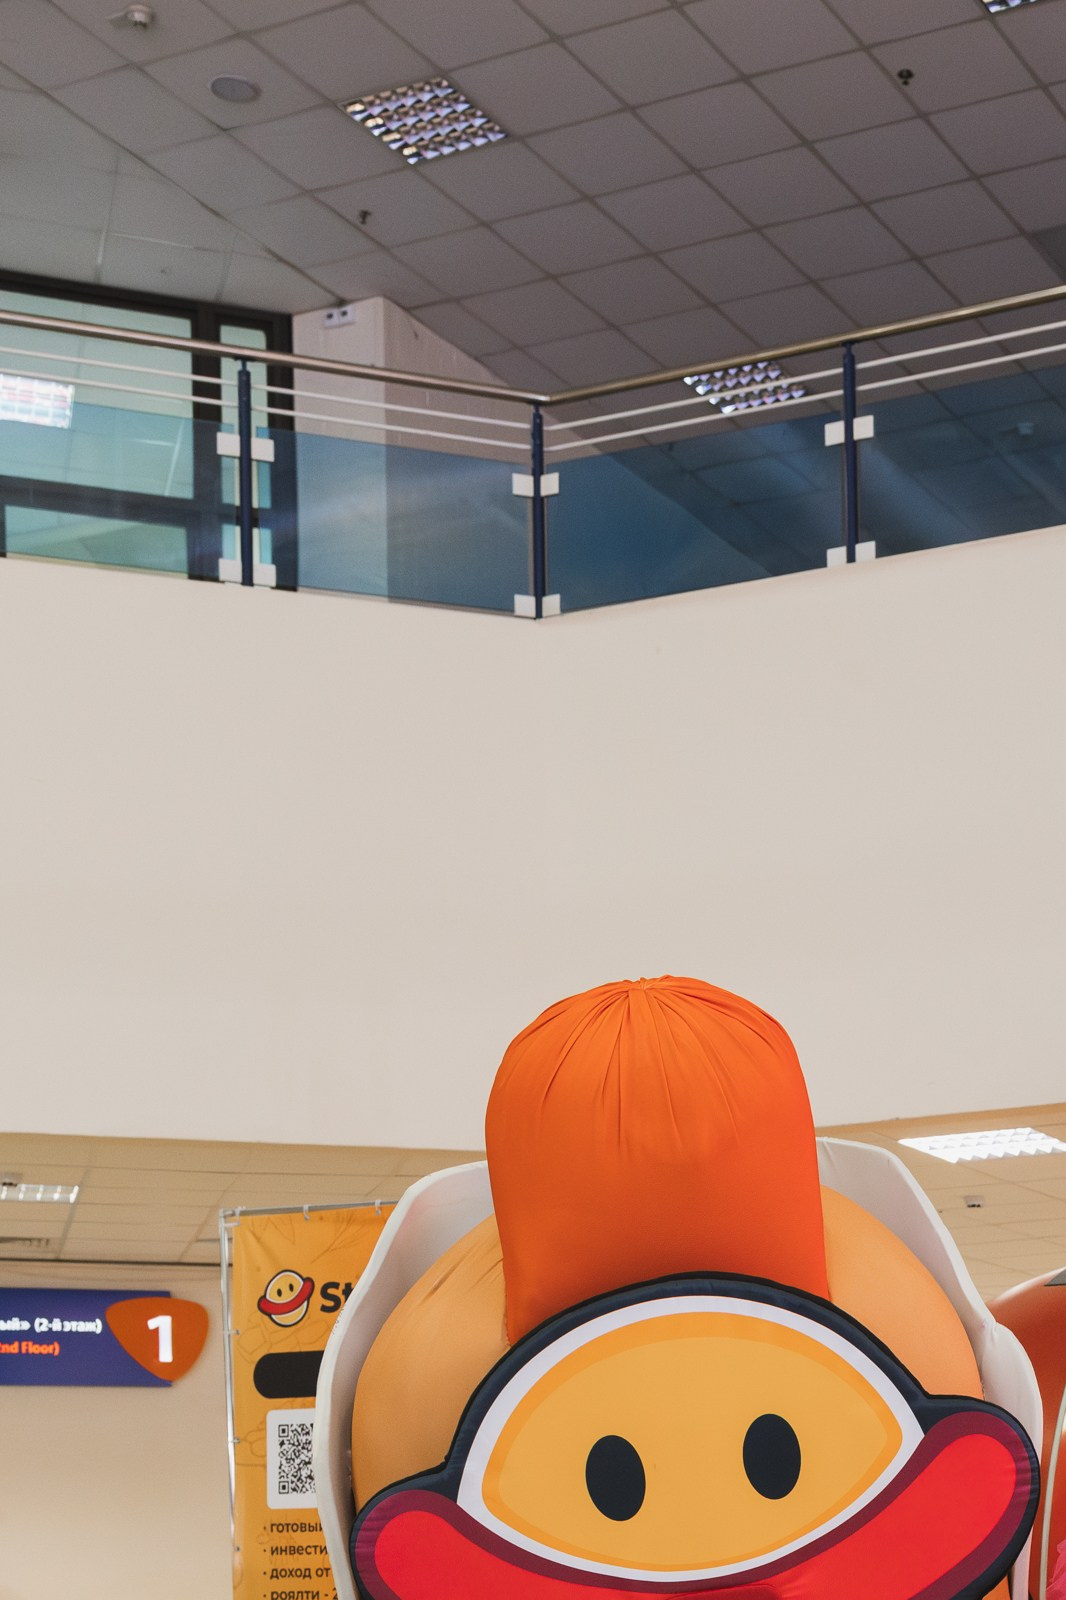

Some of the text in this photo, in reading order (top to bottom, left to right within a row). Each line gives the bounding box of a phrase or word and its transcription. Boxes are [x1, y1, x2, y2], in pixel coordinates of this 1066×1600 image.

[147, 1315, 173, 1363] 1
[0, 1340, 60, 1356] nd Floor)
[270, 1544, 328, 1556] инвести
[270, 1567, 331, 1580] доход от
